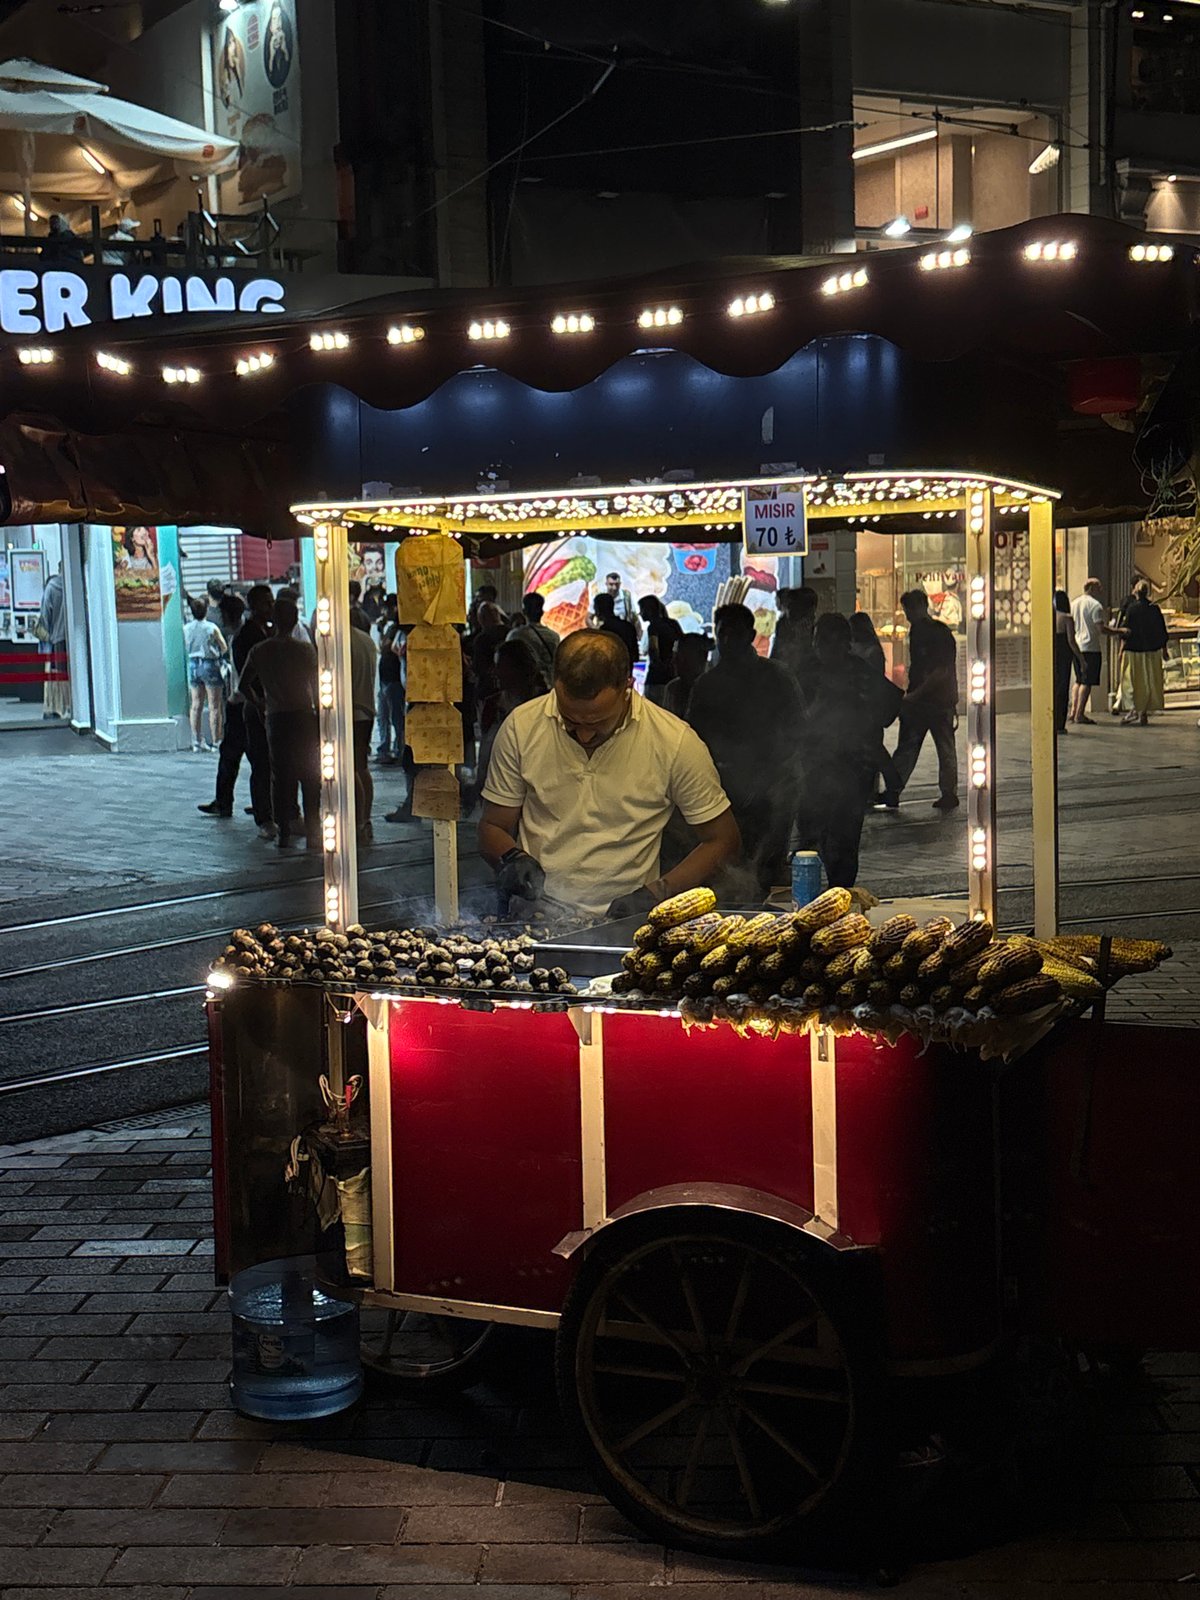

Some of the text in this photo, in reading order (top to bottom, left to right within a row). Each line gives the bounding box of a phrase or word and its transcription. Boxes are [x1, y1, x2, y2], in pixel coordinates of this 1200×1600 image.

[0, 269, 92, 334] ER
[754, 503, 796, 519] MISIR
[755, 526, 778, 547] 70
